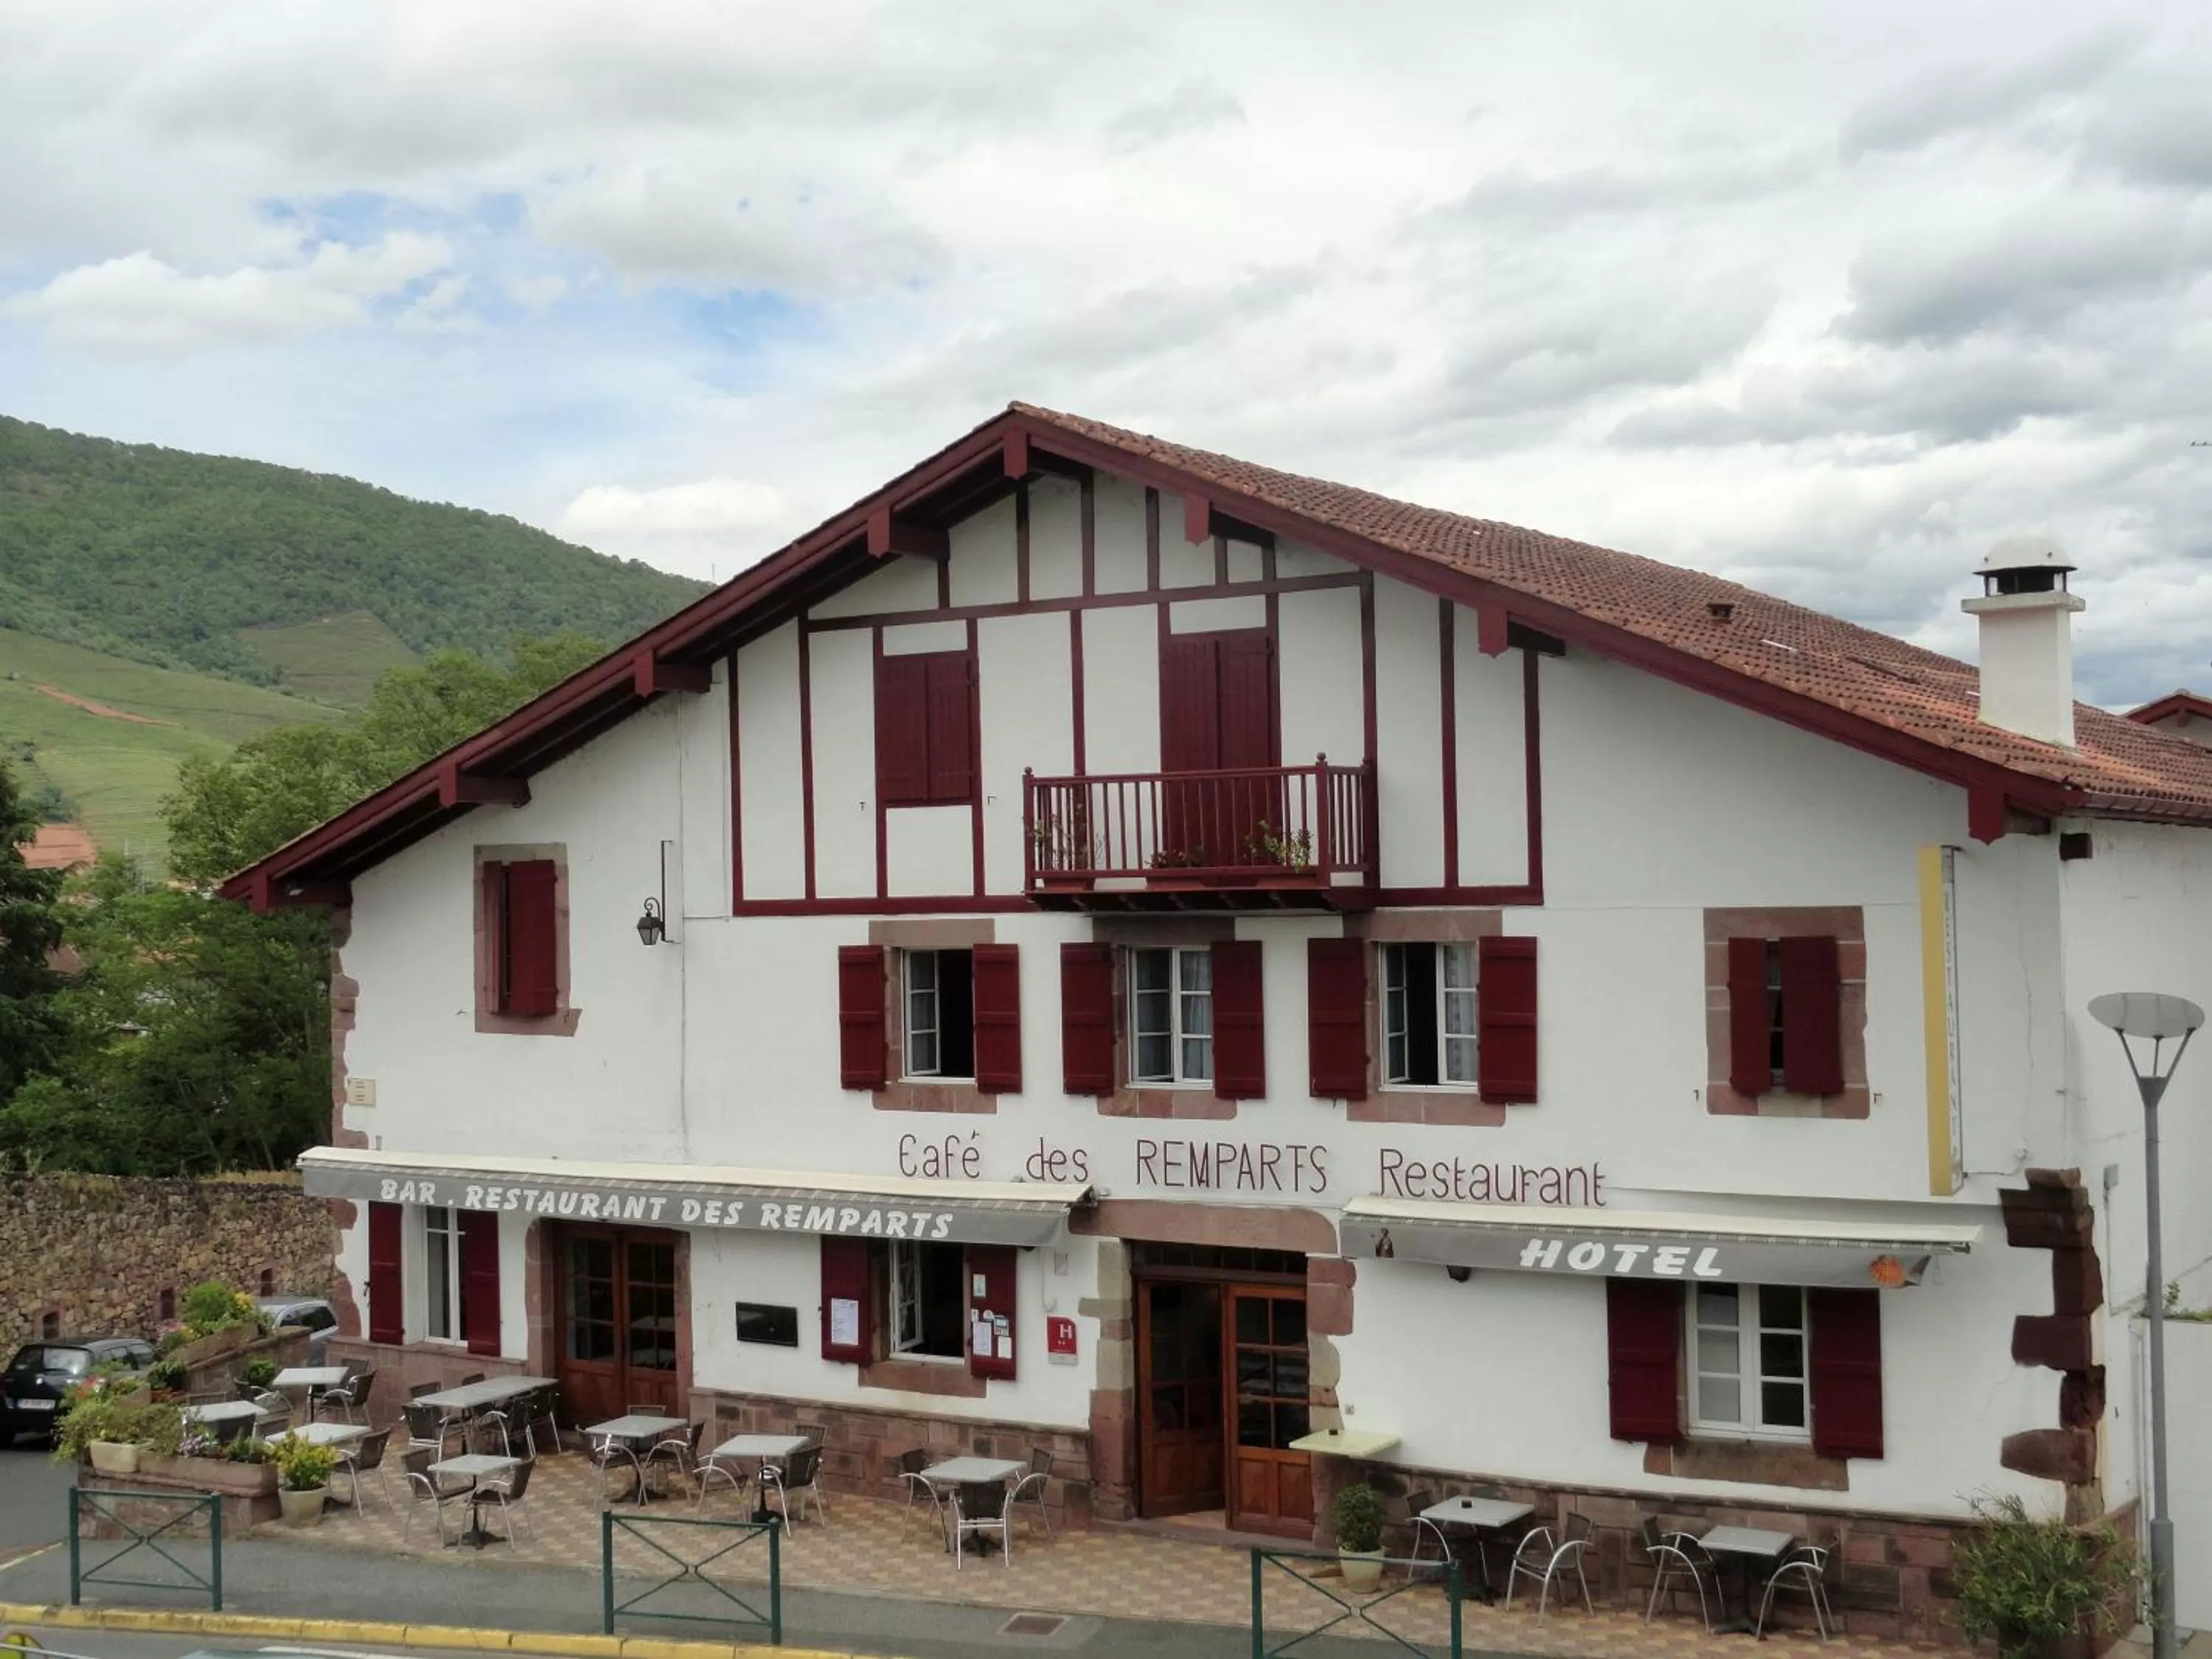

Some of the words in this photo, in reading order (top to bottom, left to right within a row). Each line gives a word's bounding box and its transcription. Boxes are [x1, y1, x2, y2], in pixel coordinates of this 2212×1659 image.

[899, 1130, 980, 1178] Café
[1026, 1137, 1089, 1182] des
[1136, 1139, 1328, 1193] REMPARTS
[1379, 1148, 1607, 1206] Restaurant
[380, 1179, 436, 1205] BAR
[465, 1185, 667, 1220] RESTAURANT
[681, 1197, 743, 1225] DES
[760, 1203, 953, 1238] REMPARTS
[1520, 1238, 1722, 1277] HOTEL
[1060, 1324, 1073, 1339] H
